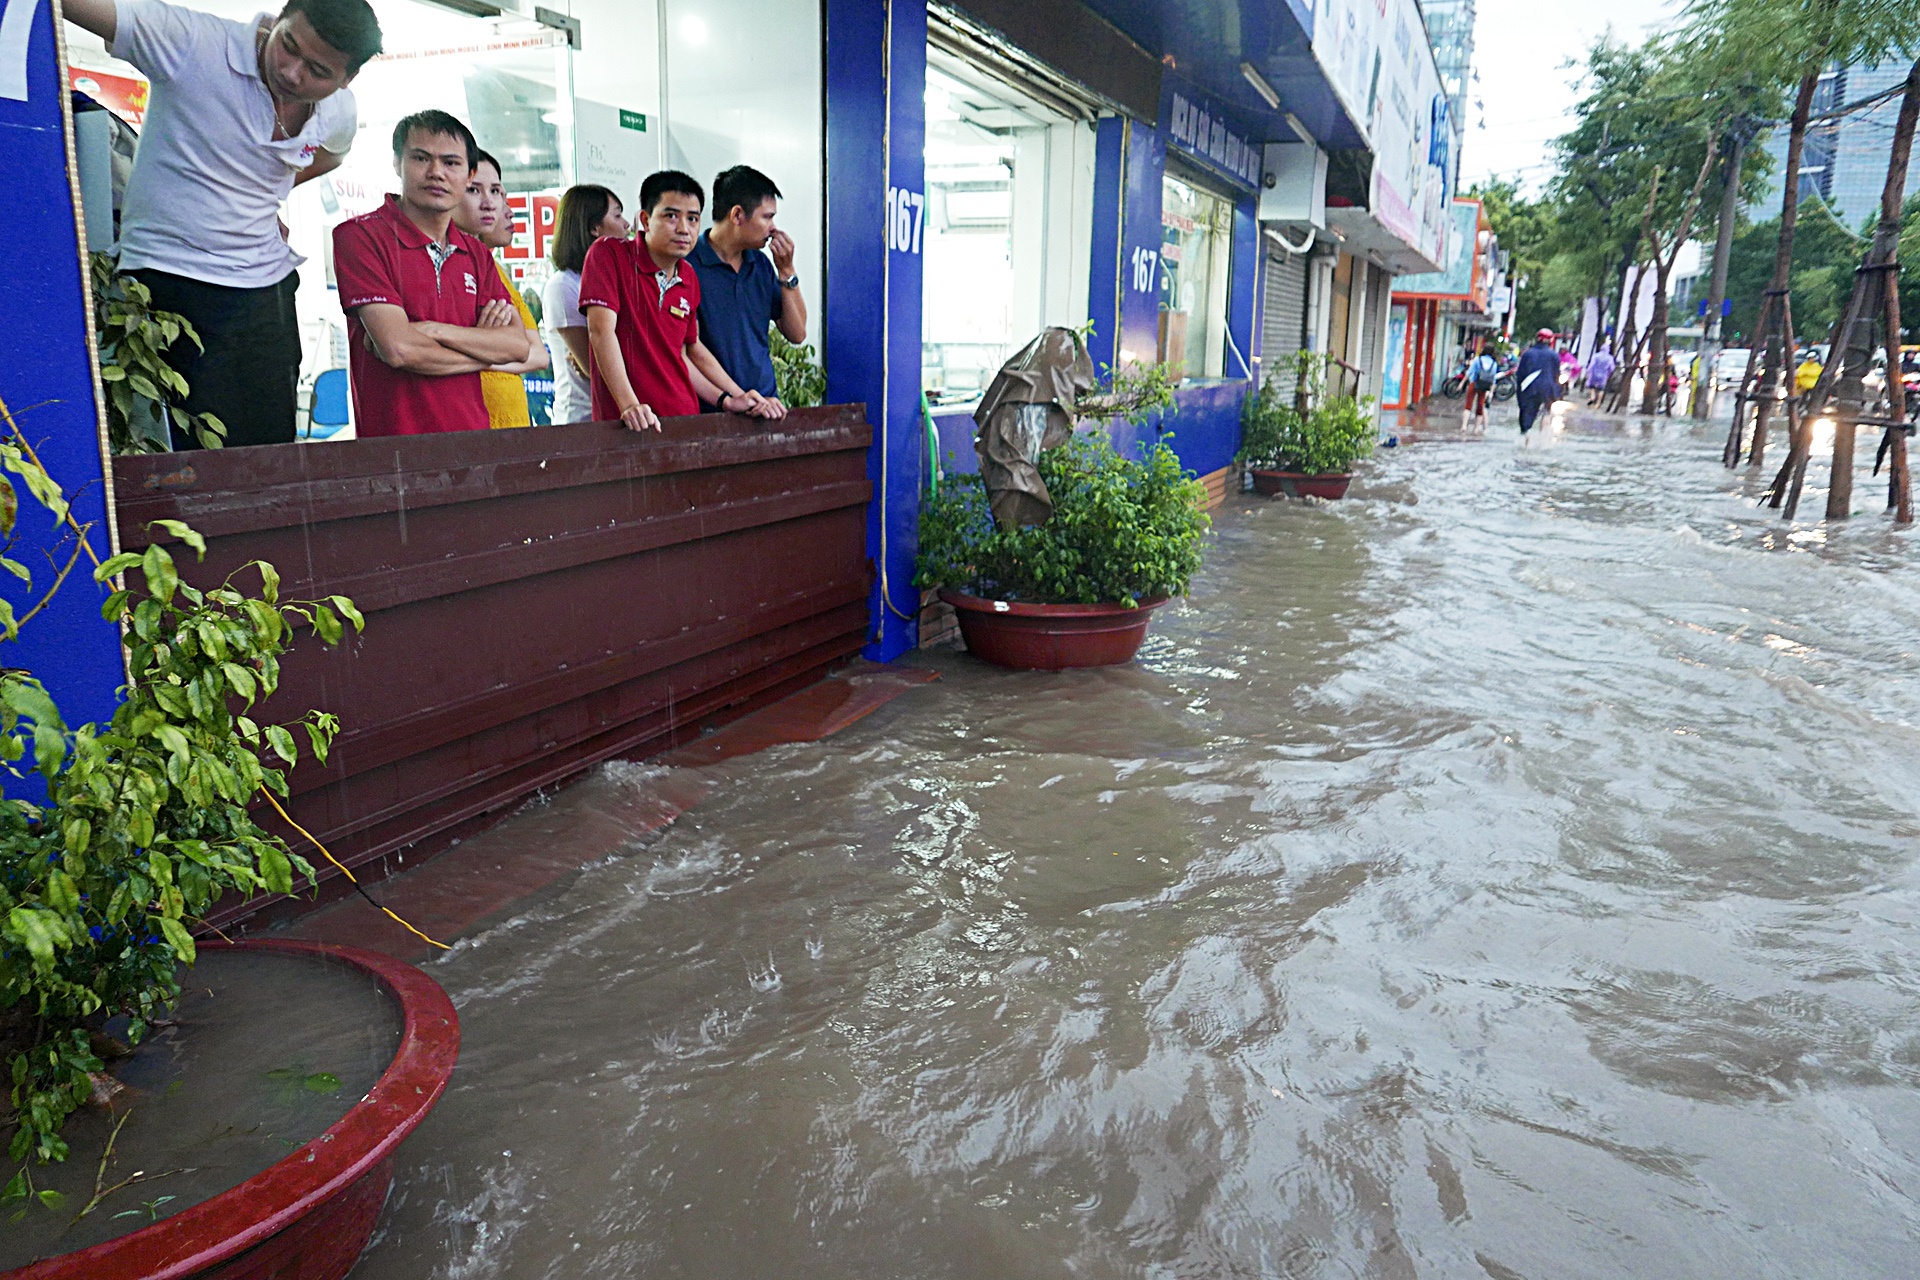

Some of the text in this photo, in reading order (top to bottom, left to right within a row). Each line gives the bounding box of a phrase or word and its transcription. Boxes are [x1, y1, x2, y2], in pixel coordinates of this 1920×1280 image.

[440, 47, 456, 55] MINH
[457, 45, 479, 54] MOBILE
[503, 40, 520, 49] MINH
[522, 37, 544, 47] MOBILE
[887, 186, 924, 254] 167
[1131, 245, 1157, 293] 167
